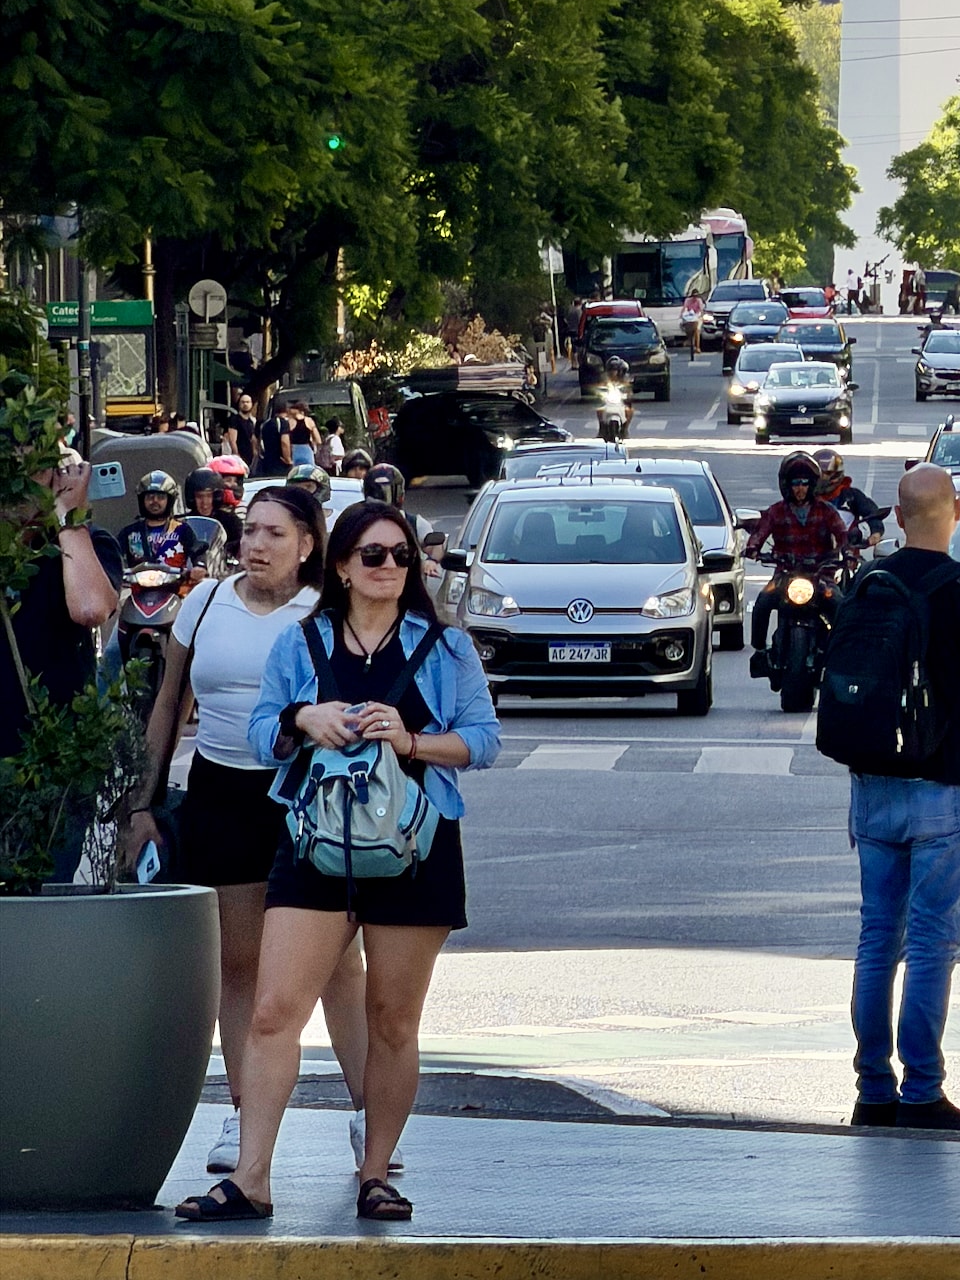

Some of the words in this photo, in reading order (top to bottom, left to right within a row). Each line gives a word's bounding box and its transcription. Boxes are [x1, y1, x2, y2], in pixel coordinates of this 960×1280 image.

[52, 305, 95, 316] Catedl
[552, 648, 566, 661] AC
[569, 648, 591, 661] 247
[594, 648, 608, 661] JR
